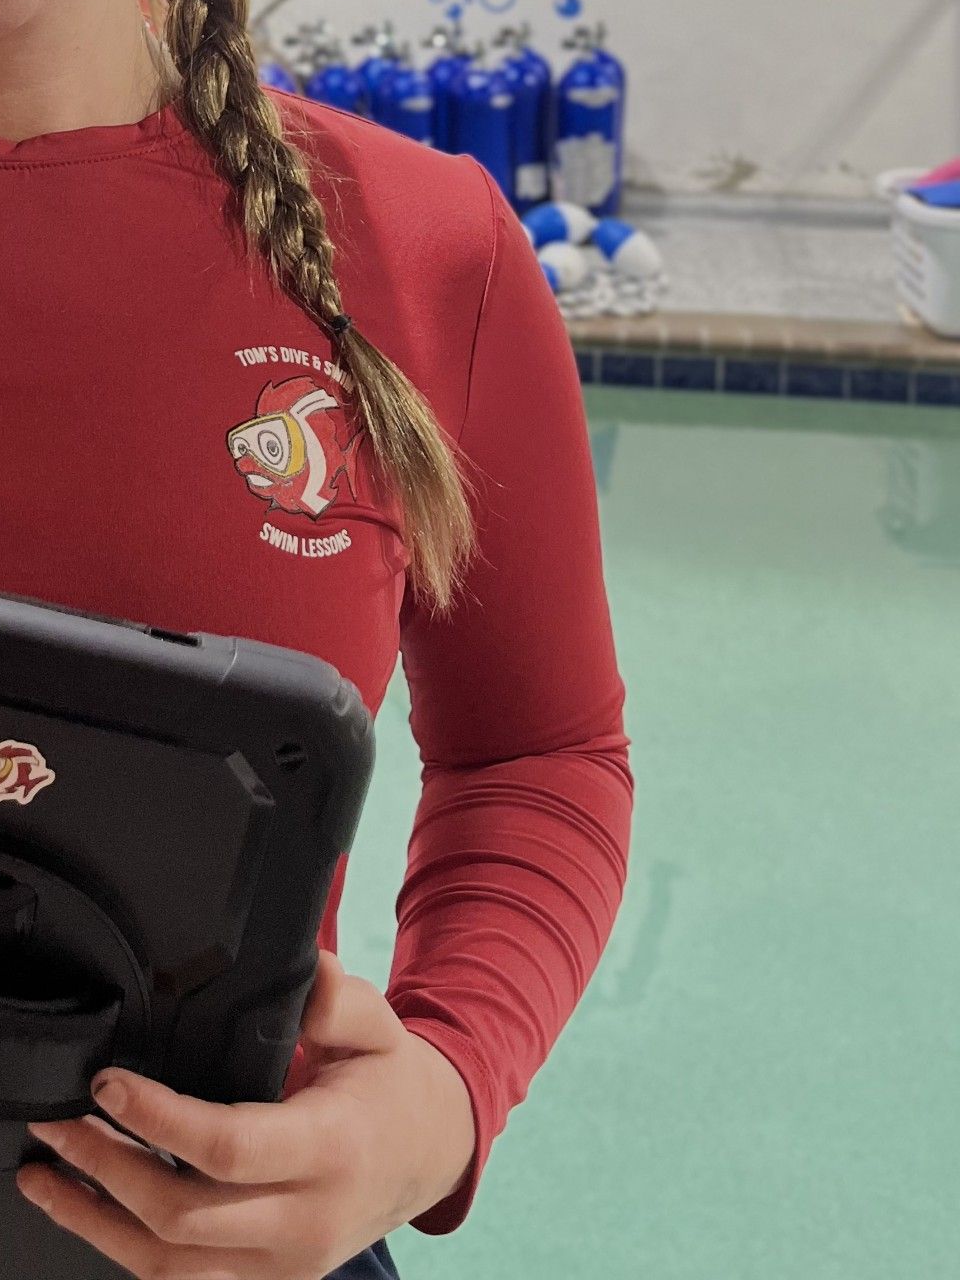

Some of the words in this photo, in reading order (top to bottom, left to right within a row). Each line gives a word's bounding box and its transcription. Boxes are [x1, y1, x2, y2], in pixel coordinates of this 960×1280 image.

[234, 345, 279, 367] TOM'S
[280, 346, 310, 367] DIVE
[311, 355, 322, 371] &
[259, 522, 299, 555] SWIM
[301, 529, 352, 558] LESSONS
